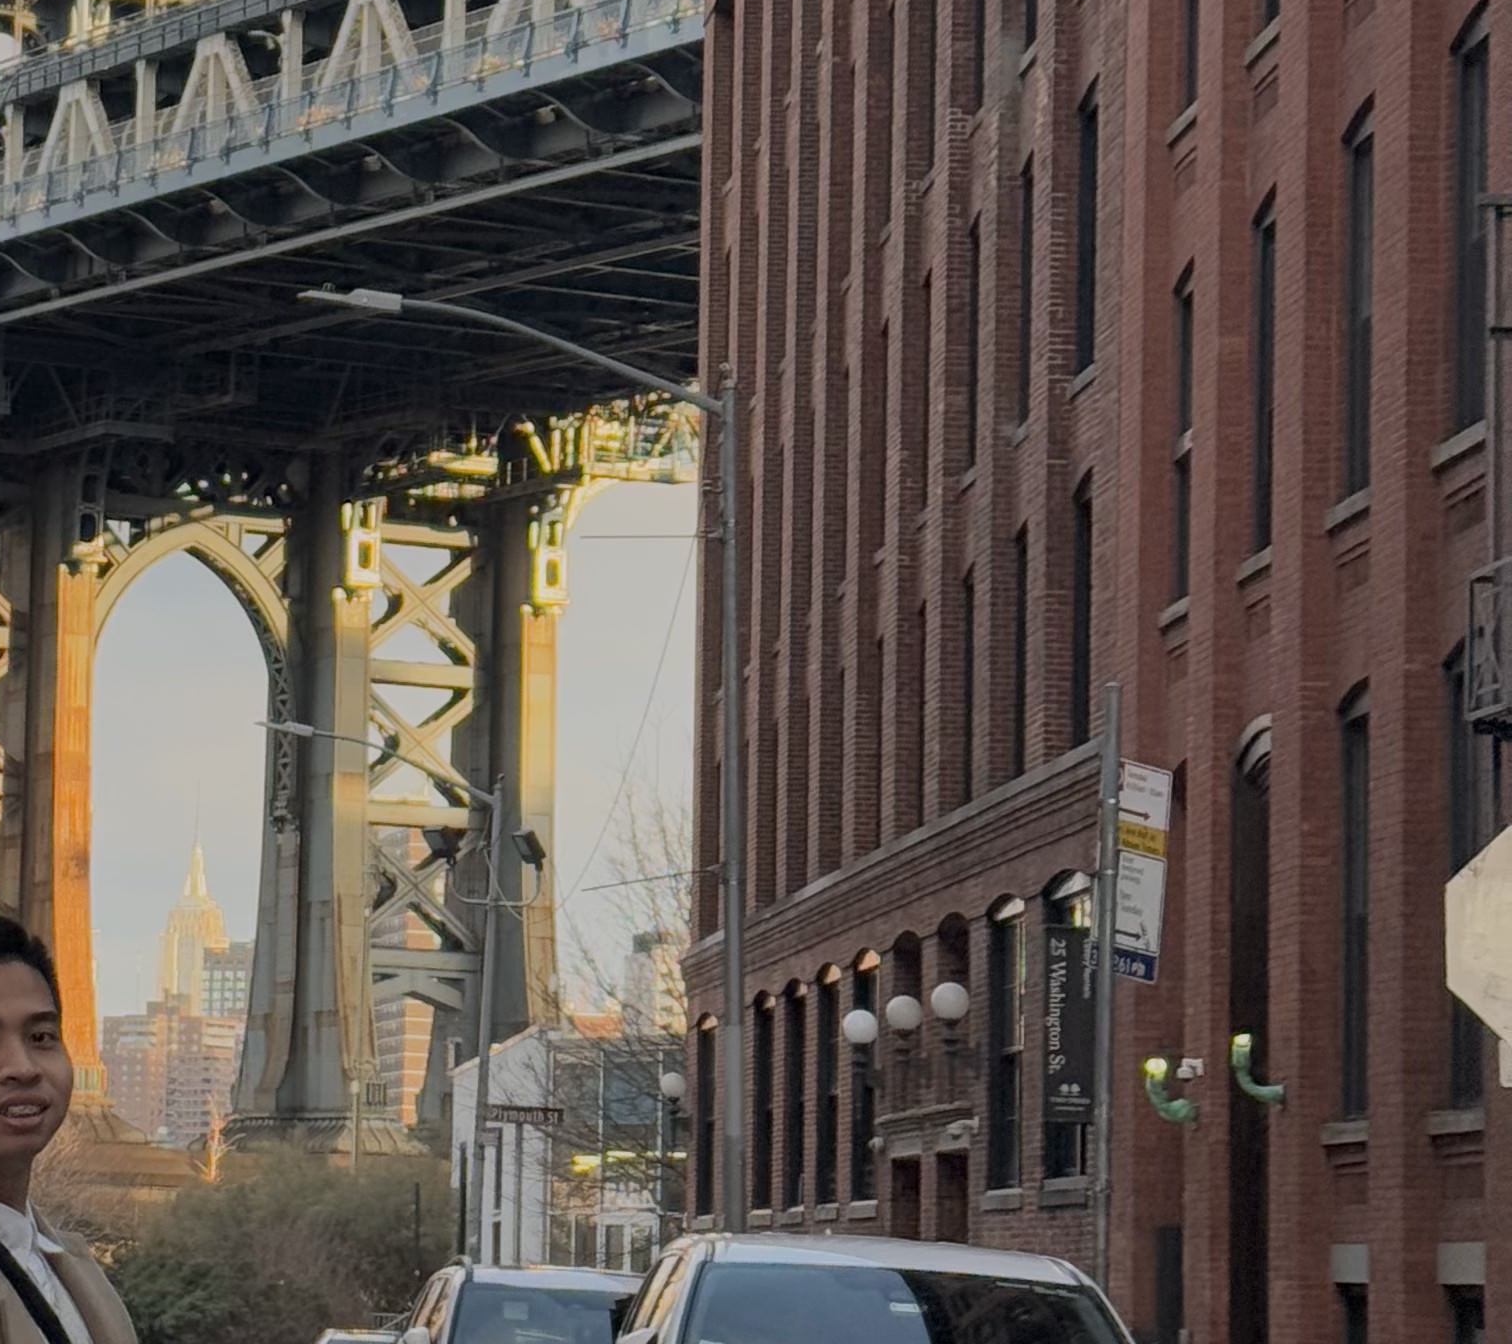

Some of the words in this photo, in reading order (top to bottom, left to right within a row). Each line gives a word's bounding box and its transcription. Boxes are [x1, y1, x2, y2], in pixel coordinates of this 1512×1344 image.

[1049, 937, 1067, 957] 25
[1045, 961, 1067, 1051] Washington
[1048, 1053, 1067, 1075] St.
[489, 1107, 544, 1122] Plymouth
[547, 1111, 559, 1125] St
